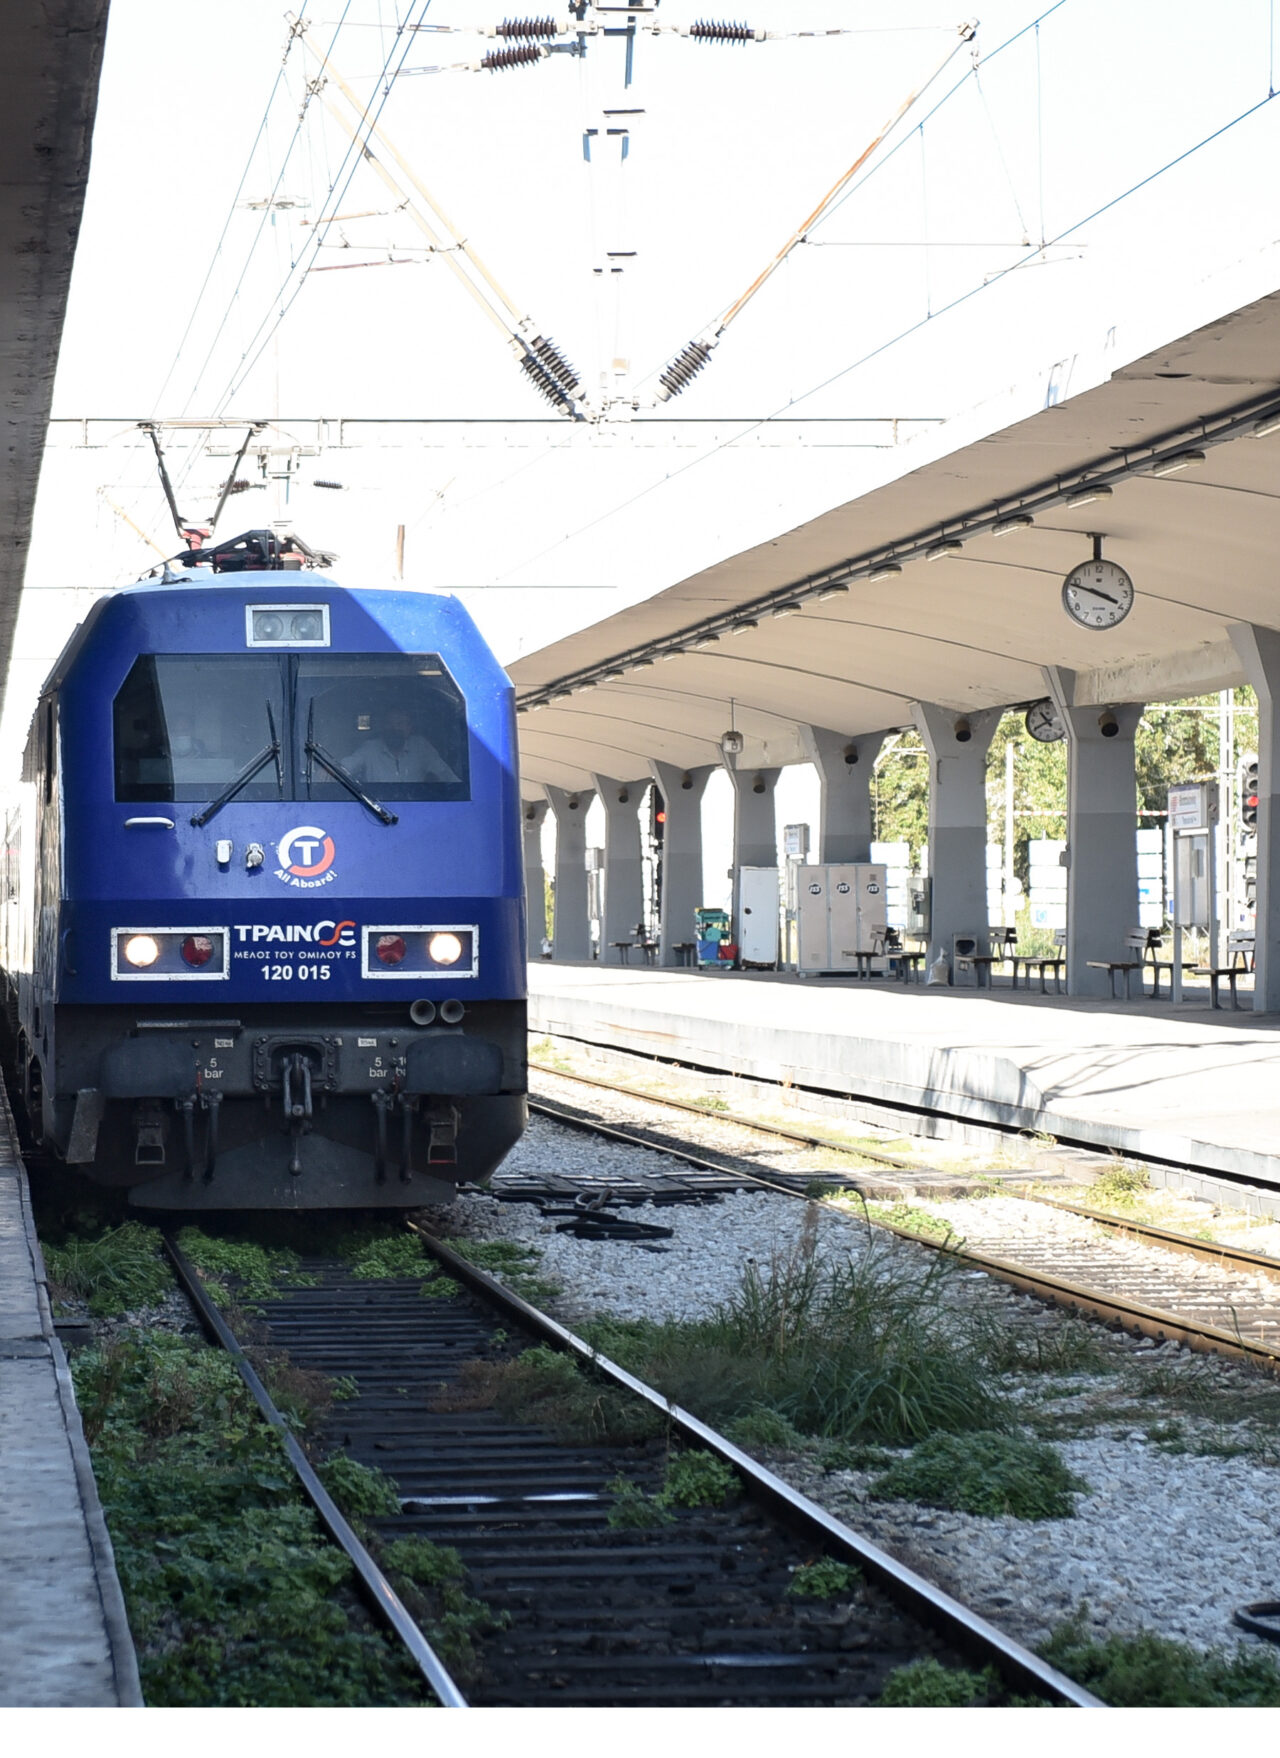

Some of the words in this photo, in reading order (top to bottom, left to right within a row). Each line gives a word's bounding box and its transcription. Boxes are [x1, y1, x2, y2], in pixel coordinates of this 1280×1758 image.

[1096, 565, 1104, 573] 12
[1118, 578, 1125, 586] 2
[1122, 590, 1128, 598] 3
[1074, 602, 1080, 611] 8
[1110, 612, 1115, 620] 5
[294, 841, 320, 865] T
[273, 868, 290, 883] All
[290, 870, 338, 888] Aboard!
[234, 951, 270, 959] ΜΕΛΟΣ
[275, 951, 294, 959] ΤΟΥ
[298, 951, 342, 959] ΟΜΙΛΟΥ
[261, 965, 293, 980] 120
[298, 965, 330, 980] 015
[210, 1057, 218, 1068] 5
[375, 1056, 382, 1067] 5
[204, 1068, 224, 1078] bar
[369, 1067, 388, 1078] bar
